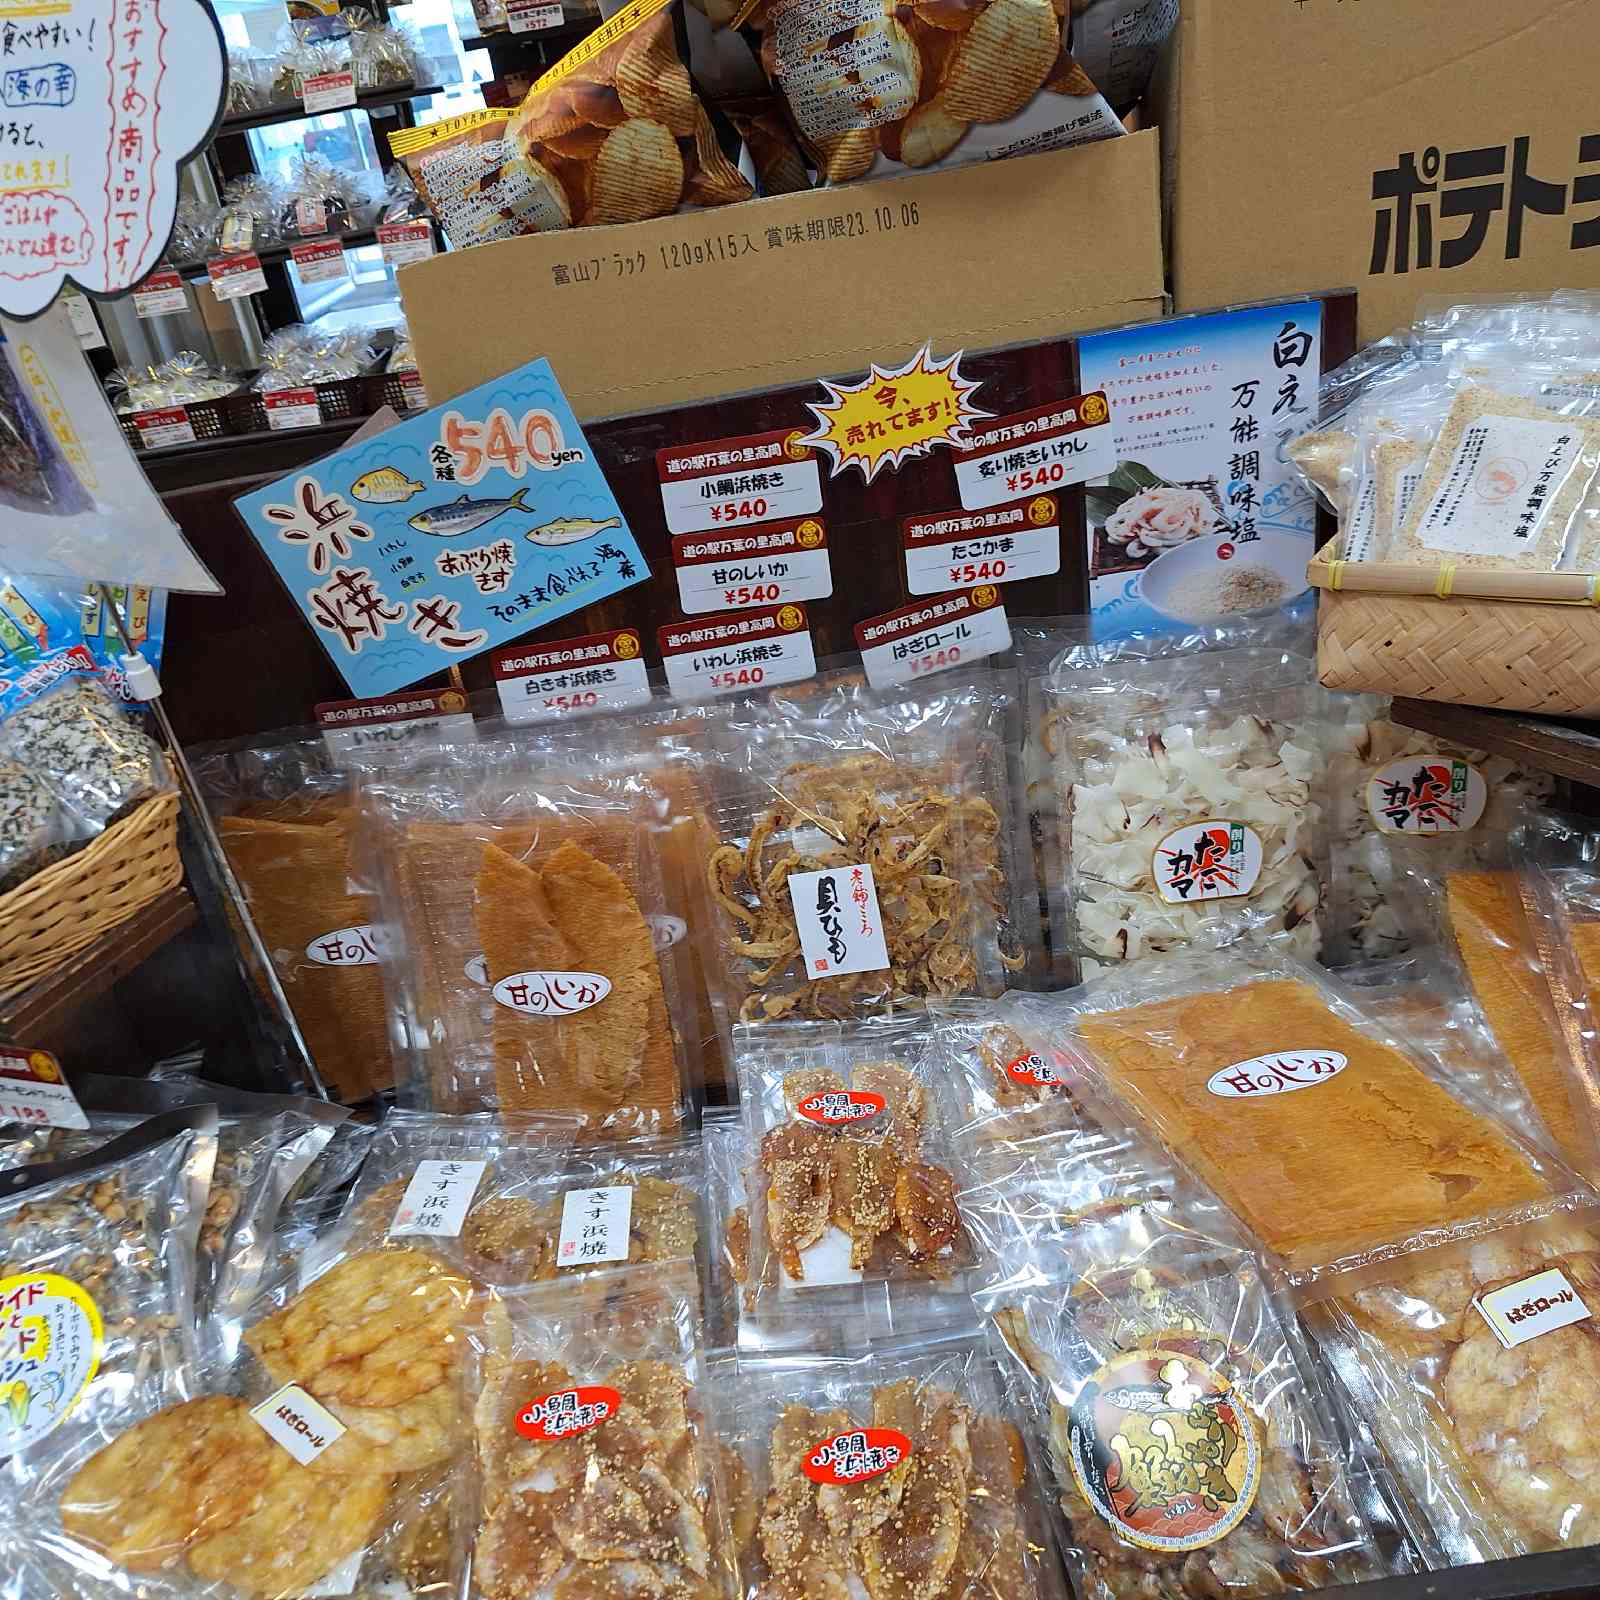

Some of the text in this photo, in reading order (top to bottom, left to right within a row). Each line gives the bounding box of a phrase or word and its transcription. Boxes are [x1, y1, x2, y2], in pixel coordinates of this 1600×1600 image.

[2, 18, 96, 55] 食べやすい!
[8, 65, 73, 102] 海の幸
[844, 397, 953, 446] 売れてます!
[431, 444, 456, 481] 各種
[444, 413, 584, 479] 540 yen
[665, 442, 782, 475] 道の駅万葉の里高岡
[978, 437, 1089, 478] 炙り焼きいわし
[1228, 380, 1261, 544] 万能調味塩
[700, 471, 785, 500] 小鯛浜焼き
[1512, 434, 1572, 540] 白えび万能調味塩
[910, 507, 1024, 538] 道の駅万葉の里高岡
[682, 531, 795, 559] 道の駅万葉の里高岡
[951, 537, 1015, 561] たこかま
[474, 567, 510, 593] きす
[712, 562, 789, 585] 甘のしいか
[667, 616, 776, 648] 道の駅万葉の里高岡
[862, 596, 970, 641] 道の駅万葉の里高岡
[500, 643, 610, 673] 道の駅万葉の里高岡
[693, 644, 784, 672] いわし浜焼き
[892, 623, 972, 661] はぎロール
[524, 668, 618, 696] 白きす浜焼き
[1167, 848, 1194, 899] カマ
[1193, 830, 1226, 891] たこ
[816, 875, 847, 965] 貝ひも
[504, 973, 600, 1013] 甘のしいか
[1216, 1056, 1336, 1094] 甘のしいか
[415, 1163, 463, 1228] きす浜焼
[580, 1190, 611, 1257] きす浜焼
[1504, 1289, 1574, 1325] はぎロール
[275, 1405, 325, 1448] はぎロール
[522, 1392, 577, 1424] 小鯛
[544, 1402, 608, 1436] 浜焼き
[811, 1432, 866, 1465] 小鯛
[834, 1444, 900, 1477] 浜焼き
